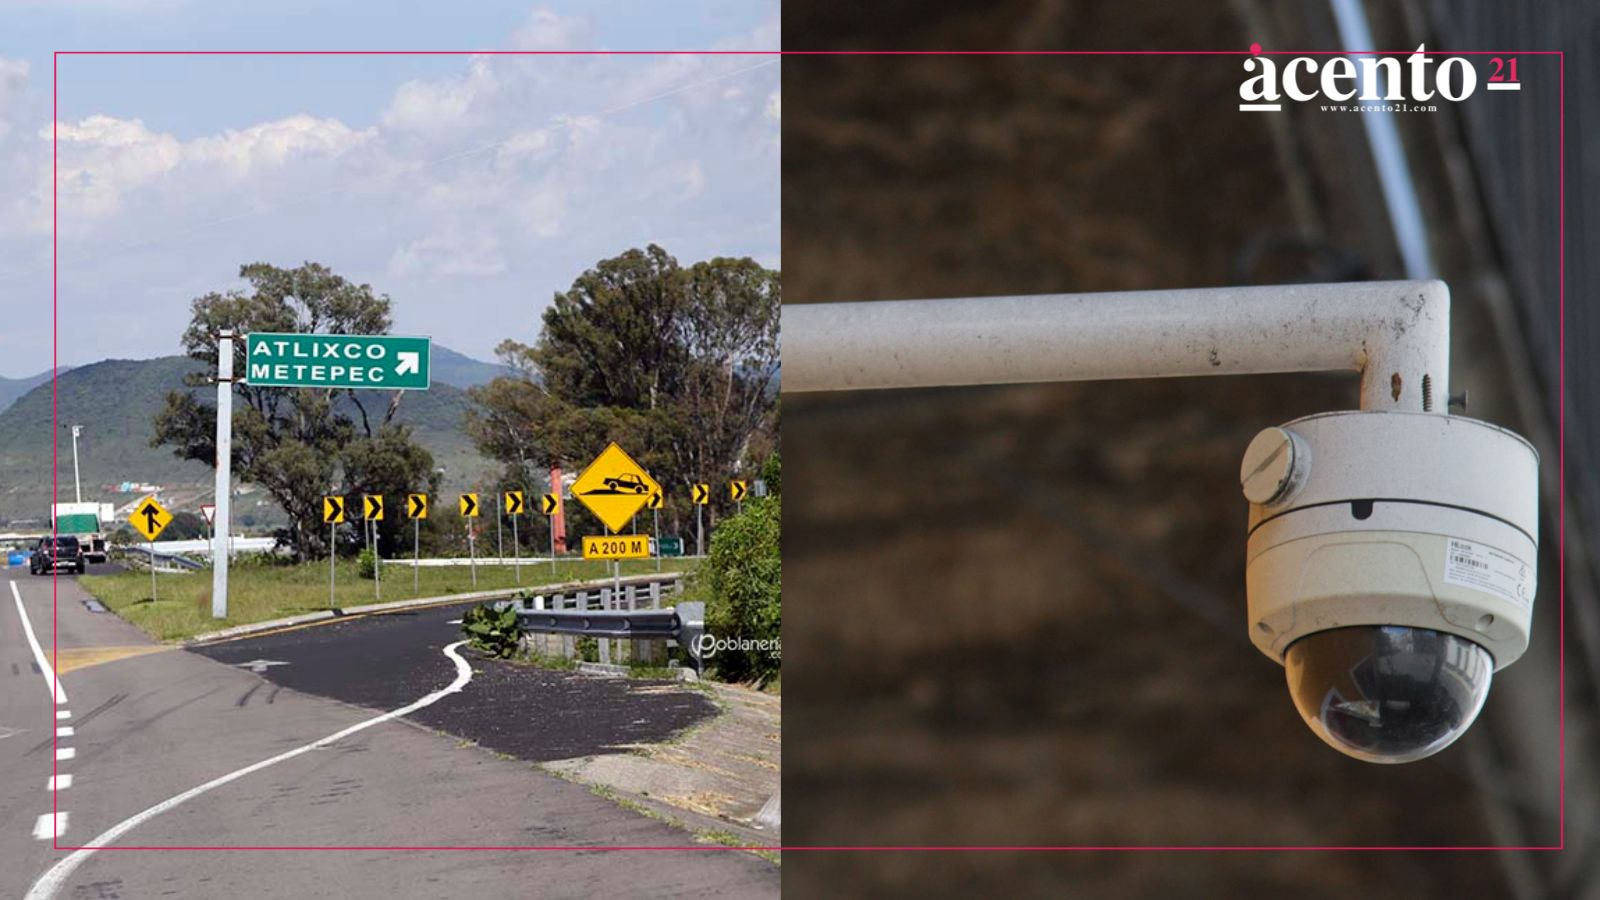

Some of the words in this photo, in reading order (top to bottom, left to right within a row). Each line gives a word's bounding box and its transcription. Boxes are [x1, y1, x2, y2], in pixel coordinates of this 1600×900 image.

[252, 341, 387, 360] ATLIXCO
[251, 364, 385, 383] METEPEC
[589, 541, 599, 555] A
[602, 541, 626, 555] 200
[631, 541, 642, 554] M
